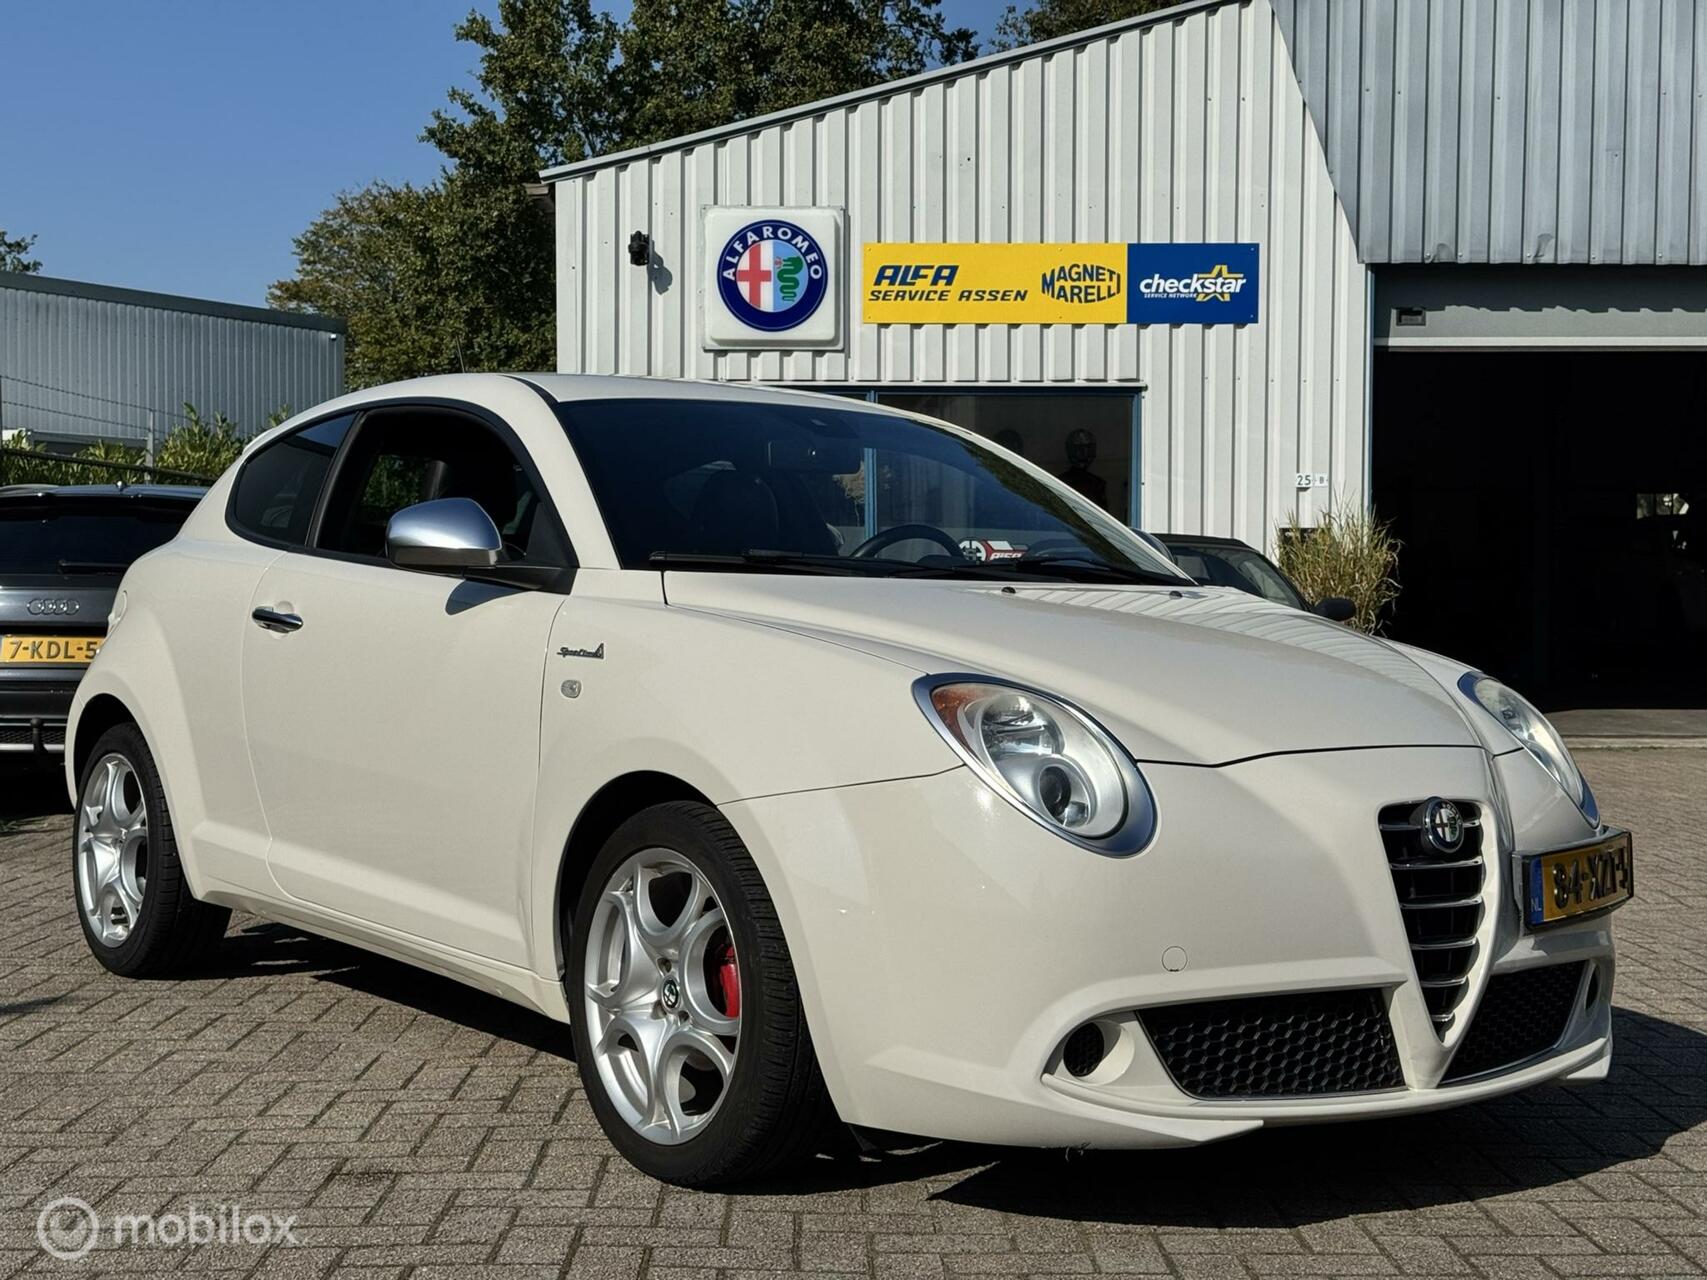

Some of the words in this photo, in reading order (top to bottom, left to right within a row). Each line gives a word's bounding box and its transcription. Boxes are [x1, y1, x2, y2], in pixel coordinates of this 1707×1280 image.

[873, 264, 959, 286] ALFA
[1041, 263, 1121, 285] MAGNETI
[1139, 273, 1247, 294] checkstar
[868, 290, 950, 302] SERVICE
[957, 289, 1028, 302] ASSEN
[1041, 283, 1121, 304] MARELLI
[1297, 474, 1311, 485] 25
